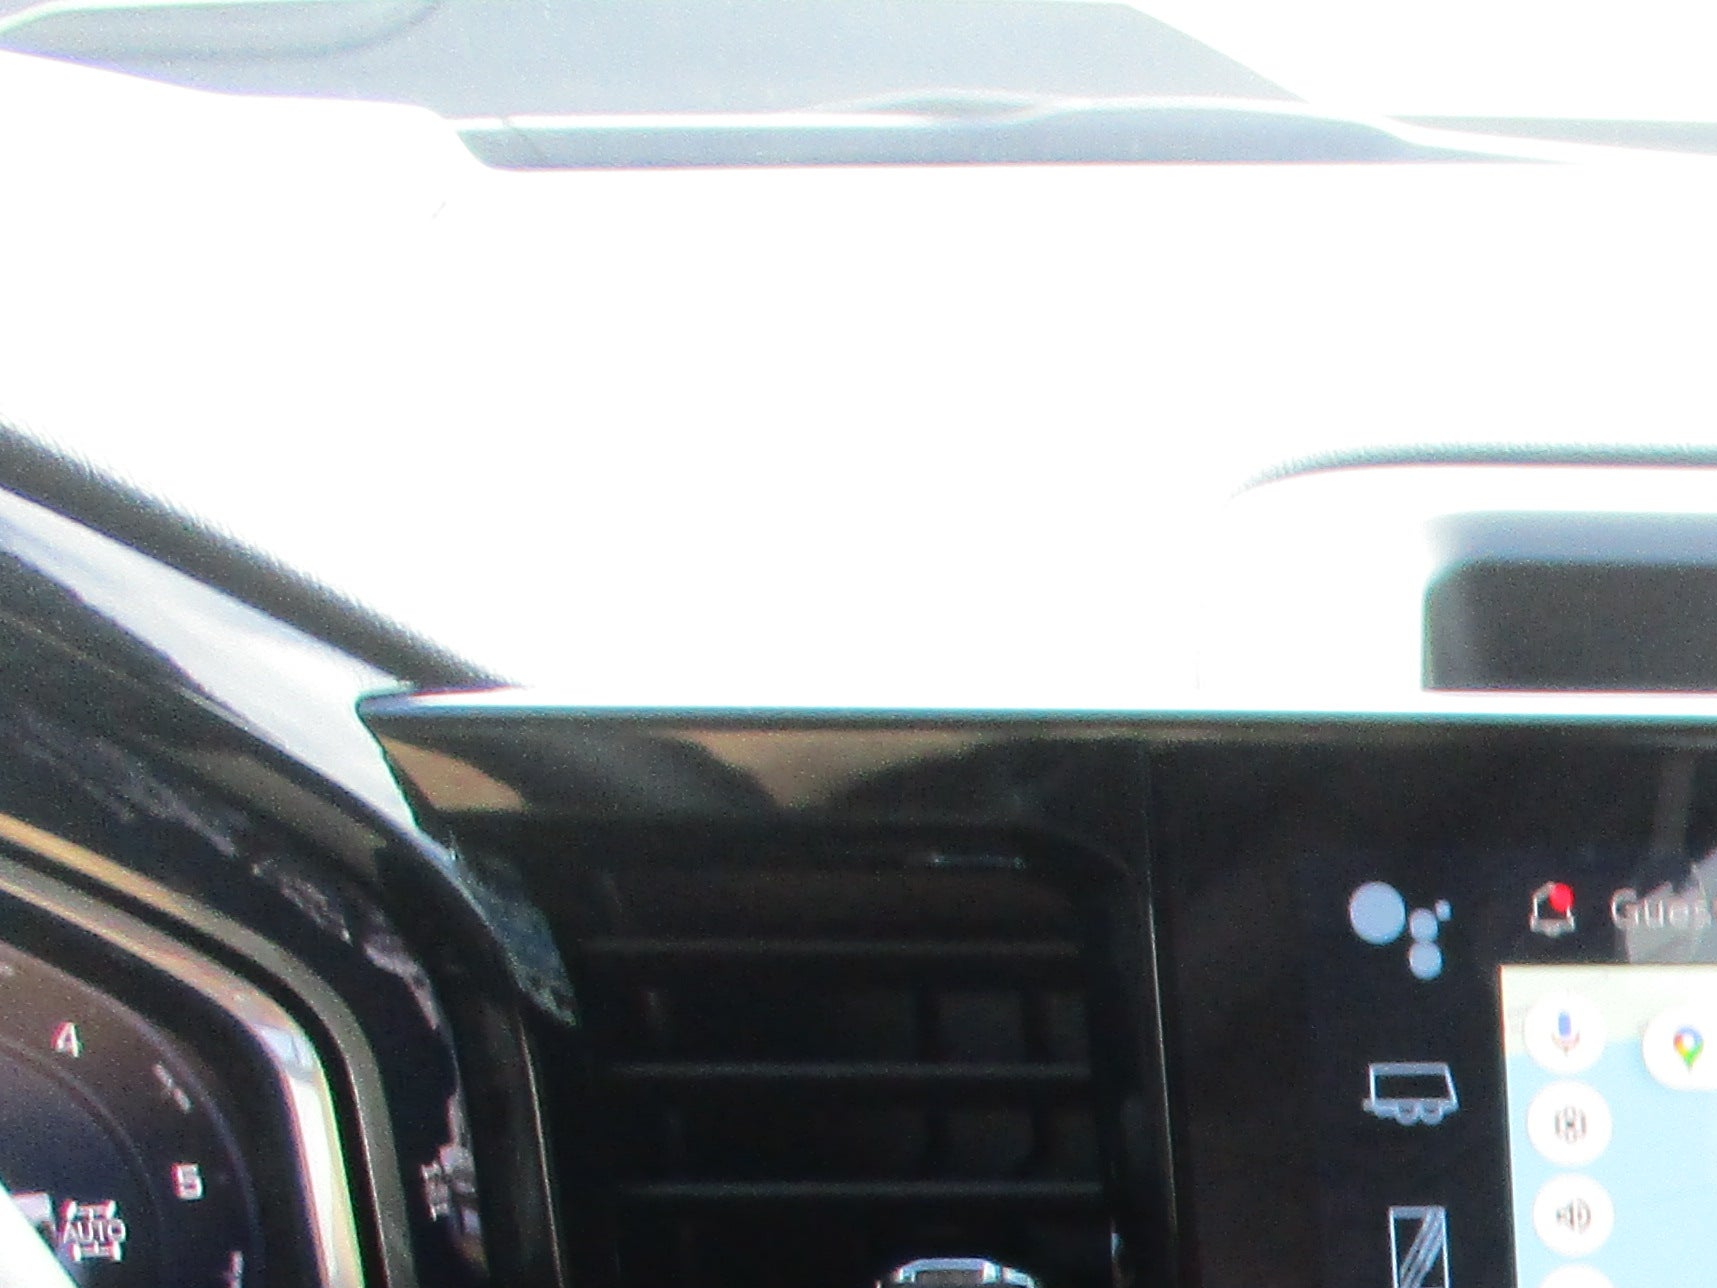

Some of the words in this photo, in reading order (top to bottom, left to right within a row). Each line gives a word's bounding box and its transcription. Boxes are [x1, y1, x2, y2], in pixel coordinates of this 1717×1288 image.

[52, 1022, 81, 1058] 4
[172, 1163, 202, 1200] 5
[62, 1218, 126, 1243] AUTO
